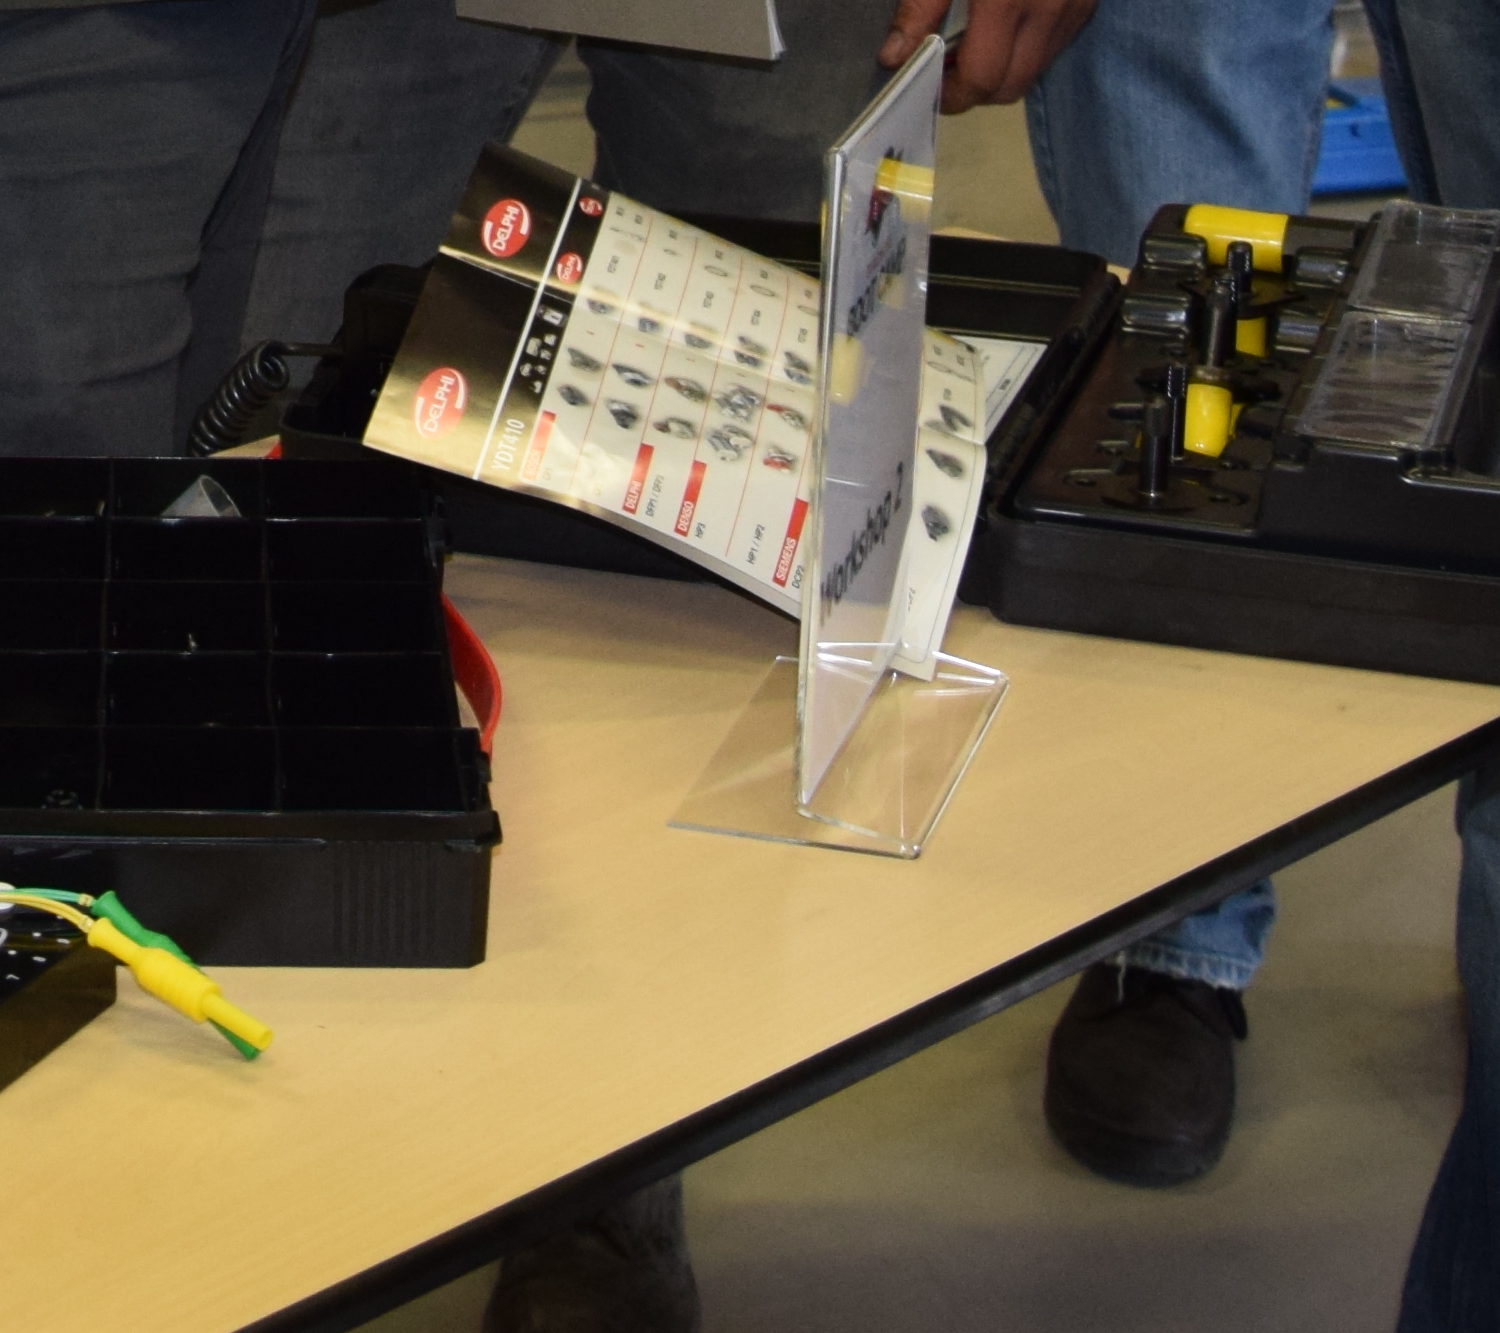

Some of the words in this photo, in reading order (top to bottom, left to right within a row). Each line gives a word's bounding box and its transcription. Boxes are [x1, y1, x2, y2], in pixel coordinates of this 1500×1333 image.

[492, 205, 520, 252] DELPHI
[423, 374, 455, 433] DELPHI
[491, 418, 526, 472] YDT410
[624, 479, 642, 510] DELPHI
[676, 500, 693, 533] DENSO
[776, 538, 797, 581] SIEMENS
